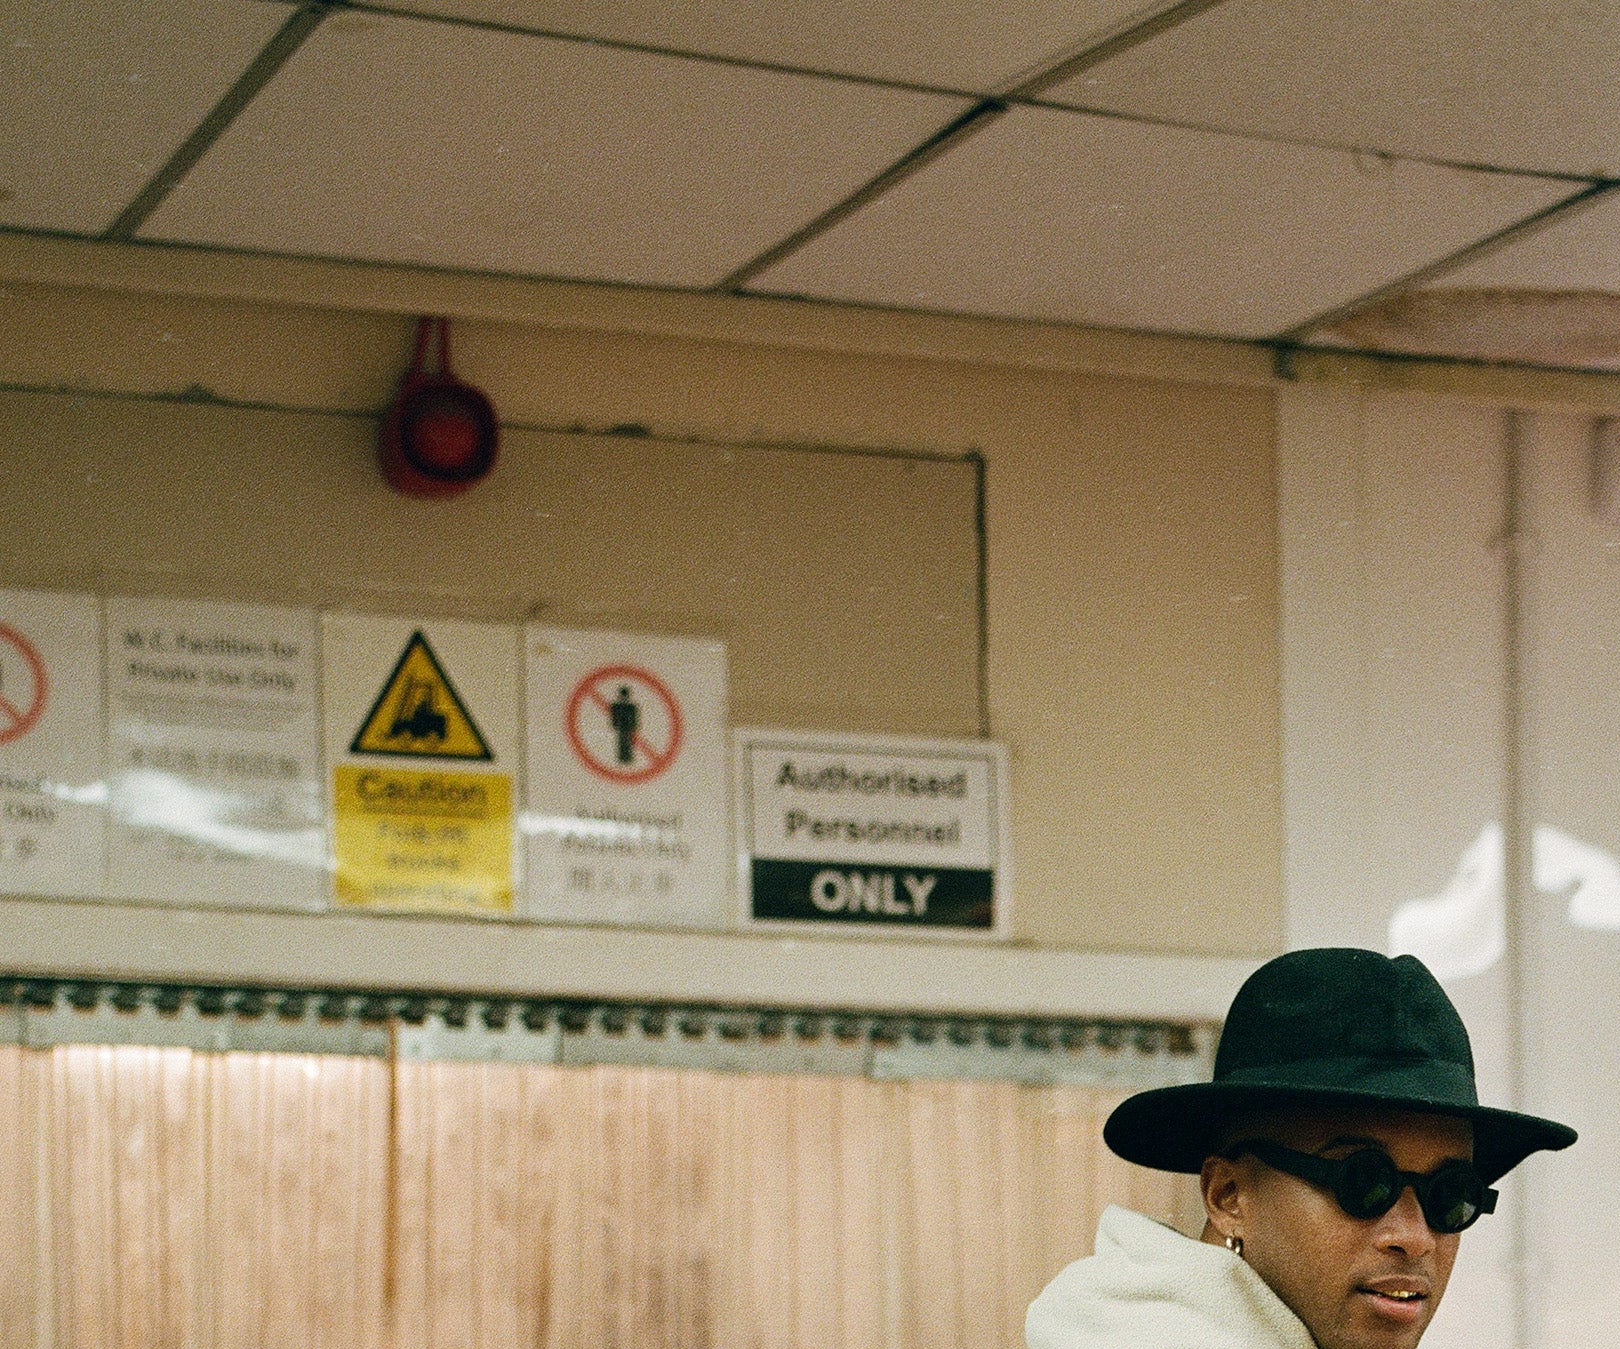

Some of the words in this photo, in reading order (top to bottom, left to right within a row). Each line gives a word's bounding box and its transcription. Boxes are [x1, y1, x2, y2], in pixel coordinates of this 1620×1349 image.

[175, 631, 263, 658] Facilities
[270, 641, 299, 660] for
[127, 660, 198, 684] Private
[204, 665, 243, 686] Use
[249, 667, 296, 692] Only
[355, 773, 487, 804] Caution
[776, 761, 966, 799] Authorised
[784, 809, 962, 845] Personnel
[809, 870, 938, 916] ONLY
